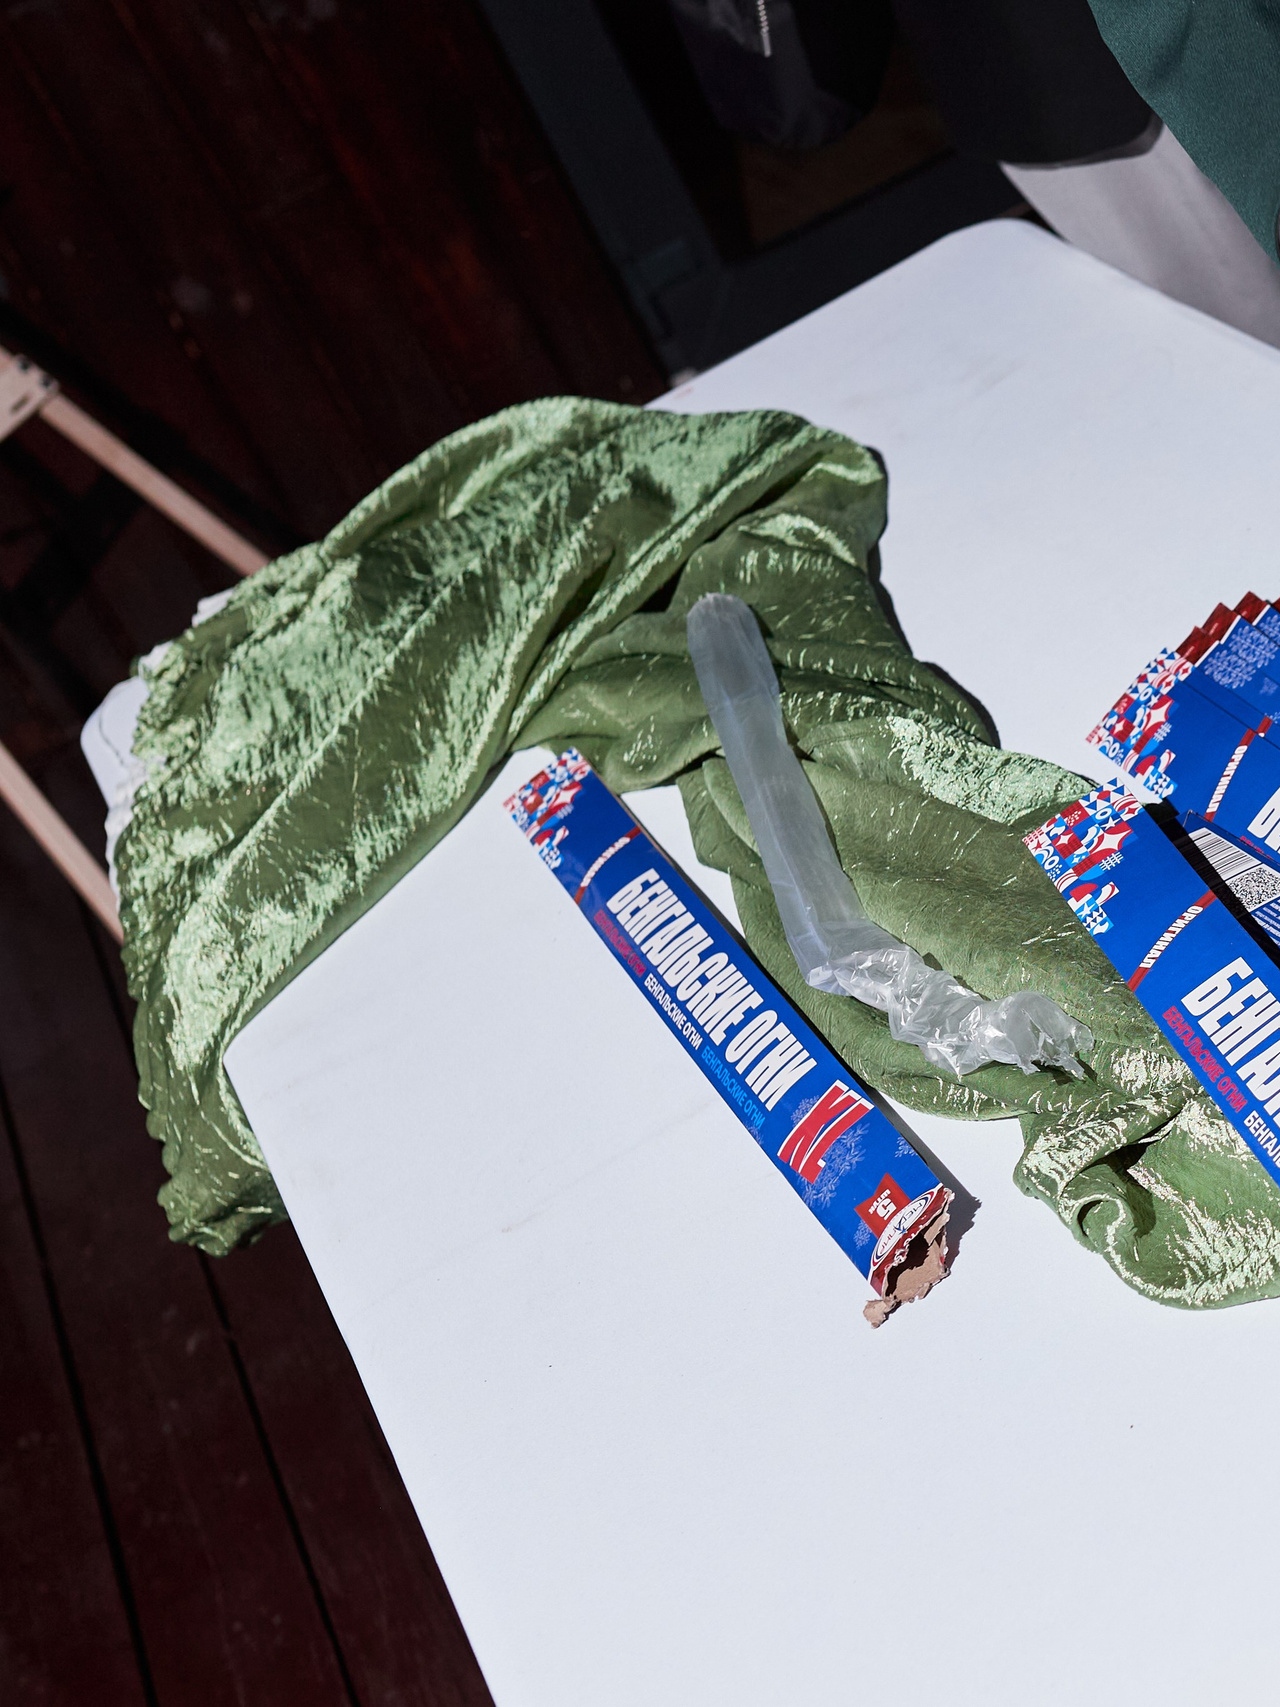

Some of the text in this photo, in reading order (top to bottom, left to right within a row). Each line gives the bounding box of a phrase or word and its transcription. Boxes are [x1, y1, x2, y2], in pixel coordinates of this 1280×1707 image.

[1206, 744, 1248, 813] ОРИГИНАЛ
[1139, 905, 1204, 969] ОРИГИНАЛ
[606, 867, 818, 1112] БЕНГАЛЬСКИЕ ОГНИ
[644, 973, 688, 1030] БЕНГАЛЬСКИЕ
[683, 1020, 704, 1051] ОГНИ
[701, 1045, 748, 1106] БЕНГАЛЬСКИЕ
[744, 1099, 766, 1130] ОГНИ
[1162, 1005, 1223, 1085] БЕНГАЛЬСКИЕ
[1215, 1073, 1249, 1115] ОГНИ
[777, 1079, 875, 1184] XL
[868, 1188, 891, 1215] ШТУК
[876, 1197, 897, 1221] 5
